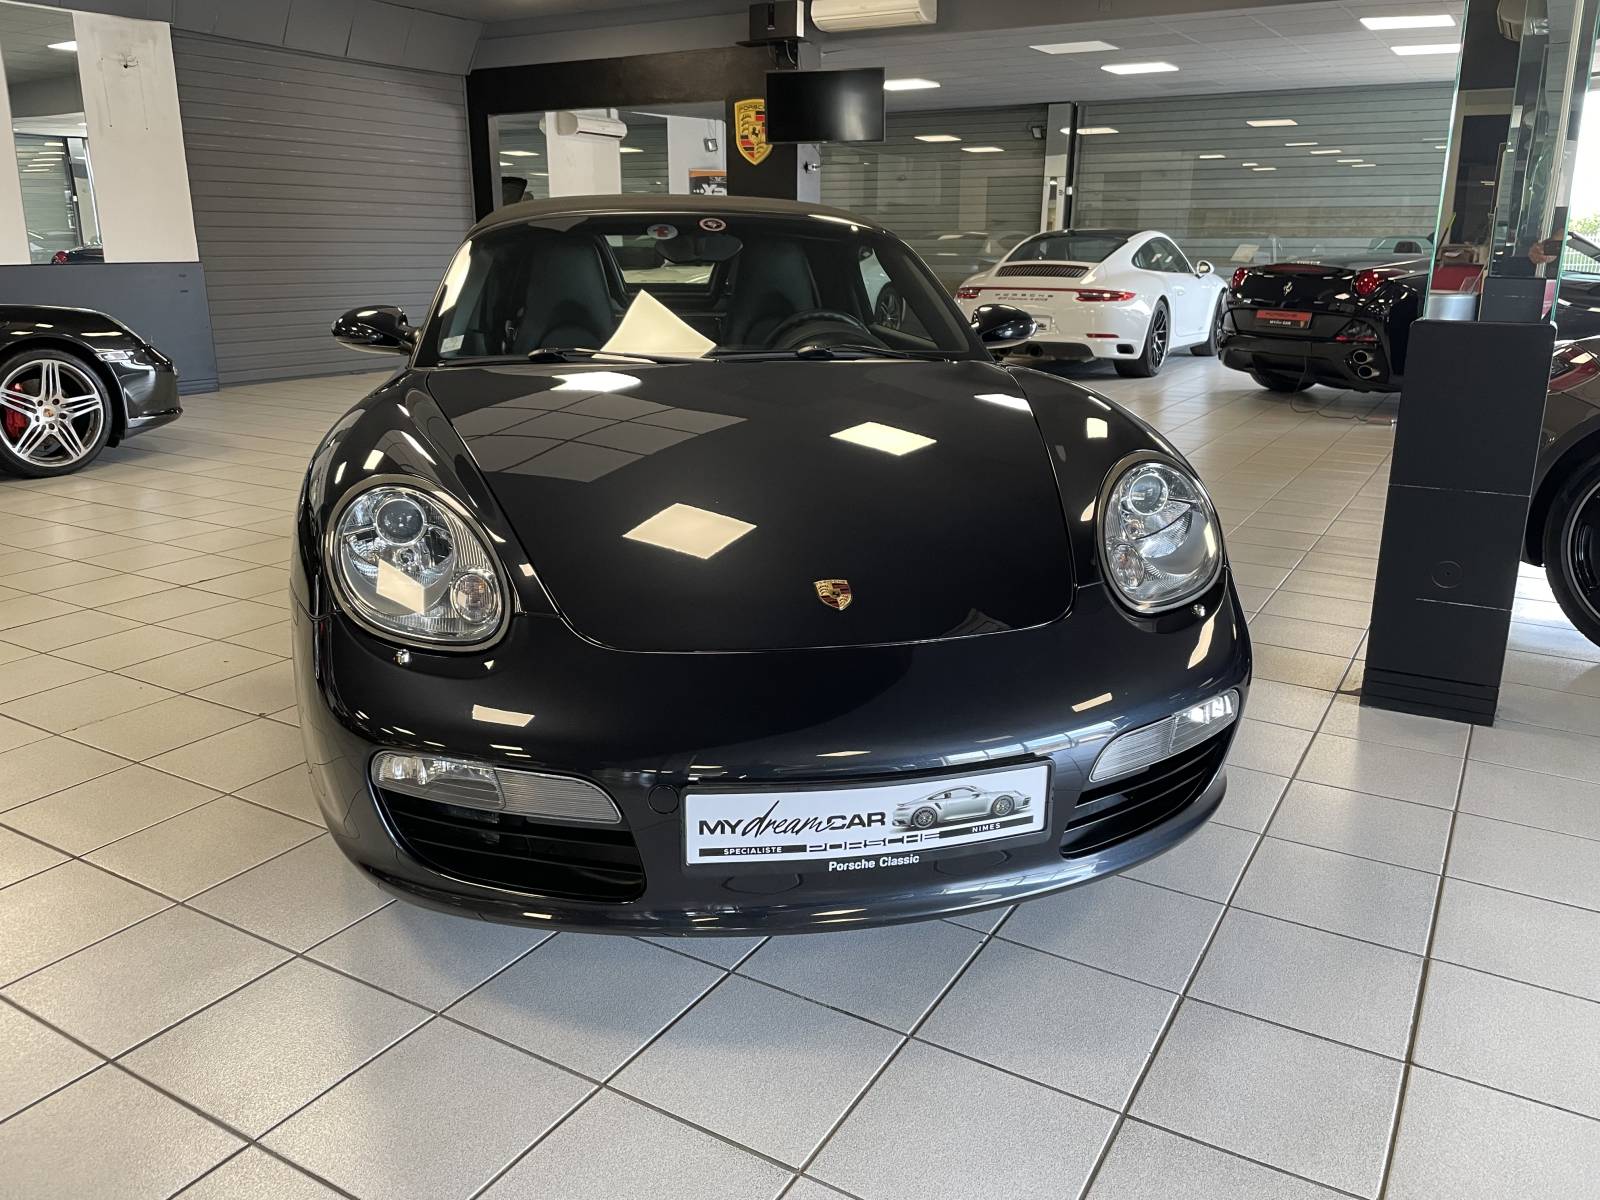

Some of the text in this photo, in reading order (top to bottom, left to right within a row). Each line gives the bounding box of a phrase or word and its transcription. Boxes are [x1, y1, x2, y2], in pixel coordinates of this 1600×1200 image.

[723, 822, 1001, 855] SPECIALISTE PORSCHE NIMES
[828, 853, 920, 872] Porsche Classic
